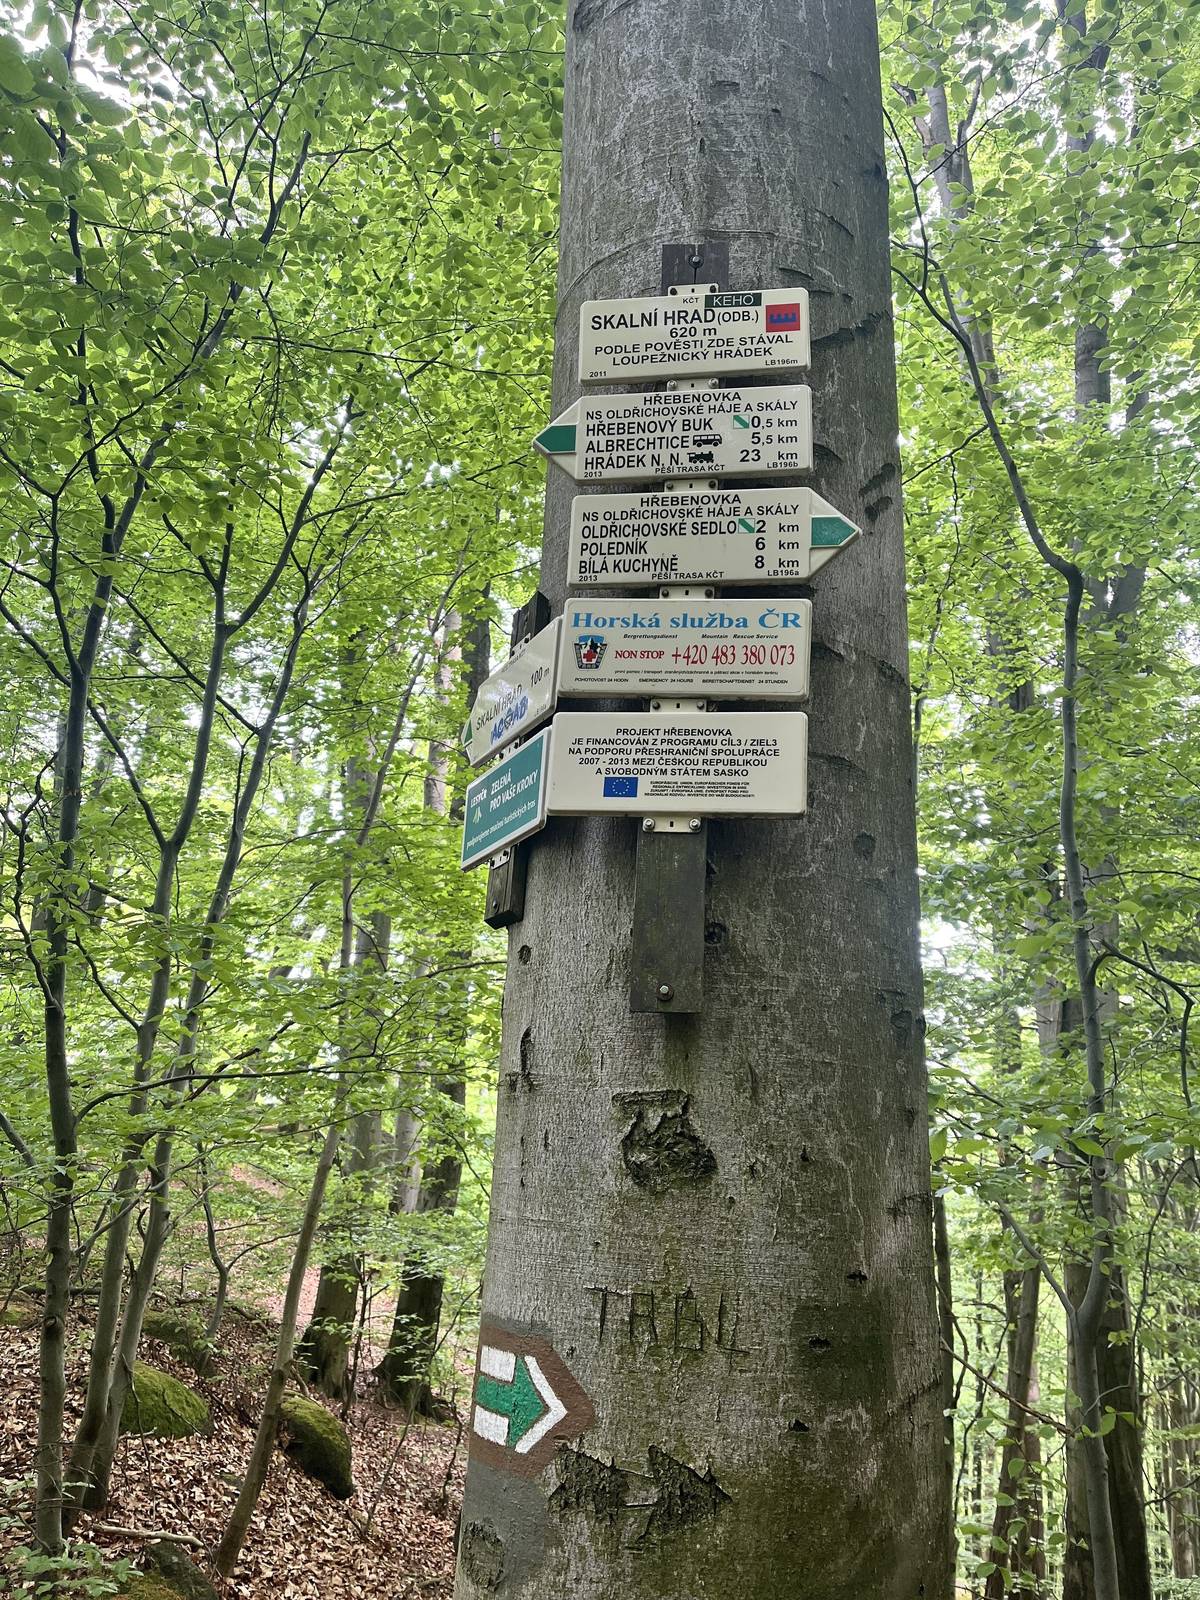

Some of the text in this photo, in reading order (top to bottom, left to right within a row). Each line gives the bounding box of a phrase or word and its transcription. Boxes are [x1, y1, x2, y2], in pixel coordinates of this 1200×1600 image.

[682, 296, 699, 304] KČT
[591, 308, 658, 330] SKALNÍ
[670, 326, 717, 338] 620 m
[595, 333, 793, 355] PODLE POVĚSTI ZDE STÁVAL
[612, 347, 773, 366] LOUPEŽNICKÝ HRÁDEK
[643, 392, 741, 405] HŘEBENOVKA
[586, 399, 798, 420] NS OLDŘICHOVSKÉ HÁJE A SKÁLY
[586, 415, 798, 437] HŘEBENOVÝ BUK 0,5 km
[585, 431, 798, 453] ALBRECHTICE 5,5 km
[585, 449, 798, 470] HRÁDEK N. N. 23 km
[655, 466, 675, 474] PĚŠÍ
[677, 465, 705, 473] TRASA
[640, 494, 741, 507] HŘEBENOVKA
[582, 503, 799, 521] NS OLDŘICHOVSKÉ HÁJE A SKÁLY
[581, 519, 799, 539] OLDŘICHOVSKÉ SEDLO 2 km
[580, 537, 799, 556] POLEDNÍK 6 km
[579, 554, 799, 574] BÍLÁ KUCHYNĚ 8 km
[651, 570, 724, 580] PĚŠÍ TRASA KČT
[572, 608, 803, 629] Horská služba ČR
[614, 644, 795, 666] NON STOP +420 483 380 073
[531, 667, 542, 687] 100
[616, 726, 732, 736] PROJEKT HŘEBENOVKA
[568, 746, 780, 756] NA PODPORU PŘESHRANIČNÍ SPOLUPRÁCE
[572, 738, 584, 746] JE
[586, 737, 649, 746] FINANCOVÁN
[651, 738, 658, 746] Z
[660, 738, 718, 746] PROGRAMU
[720, 737, 742, 746] CÍL3
[750, 738, 777, 746] ZIEL3
[579, 757, 600, 765] 2007
[608, 757, 630, 765] 2013
[702, 758, 767, 766] REPUBLIKOU
[595, 766, 749, 776] A SVOBODNÝM STÁTEM SASKO
[490, 769, 538, 812] PRO VAŠE KROKY
[491, 768, 512, 795] ZELENÁ
[527, 800, 536, 810] tras
